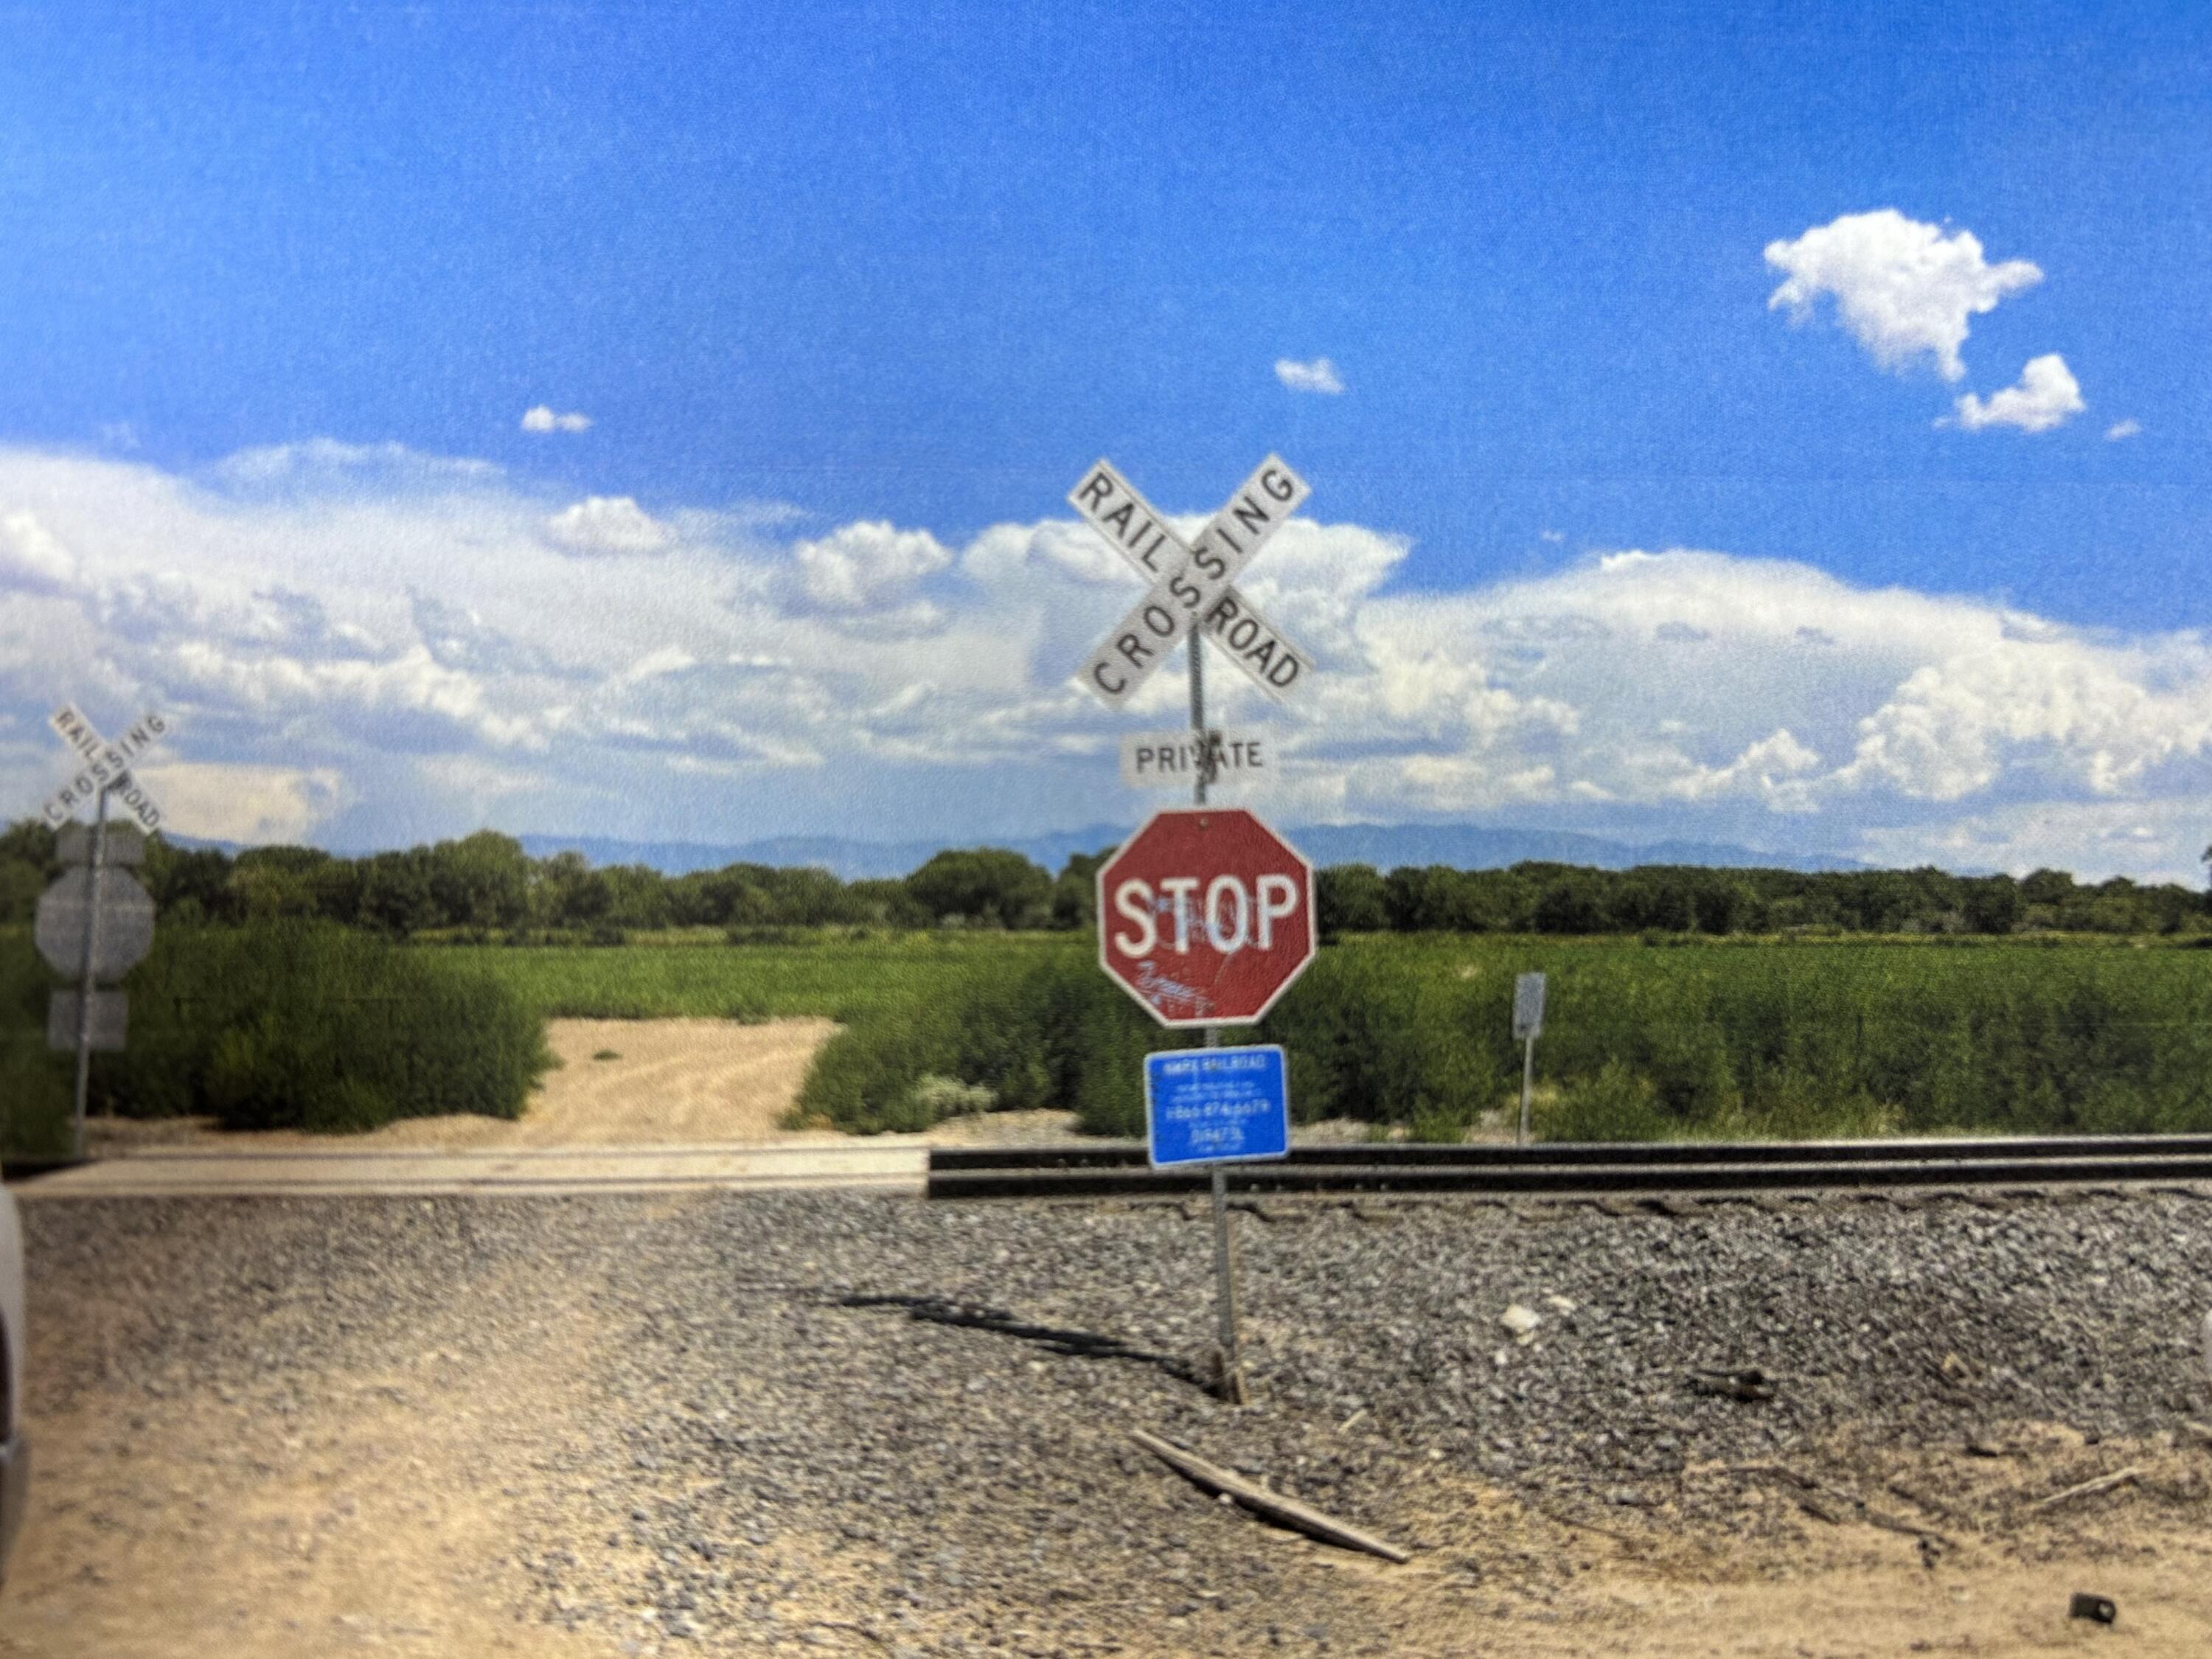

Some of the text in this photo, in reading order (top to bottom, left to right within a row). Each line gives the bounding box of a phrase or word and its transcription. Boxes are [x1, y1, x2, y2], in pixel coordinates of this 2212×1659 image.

[1093, 470, 1293, 695] CROSSING
[44, 715, 165, 821] CROSSING
[1114, 874, 1298, 958] STOP
